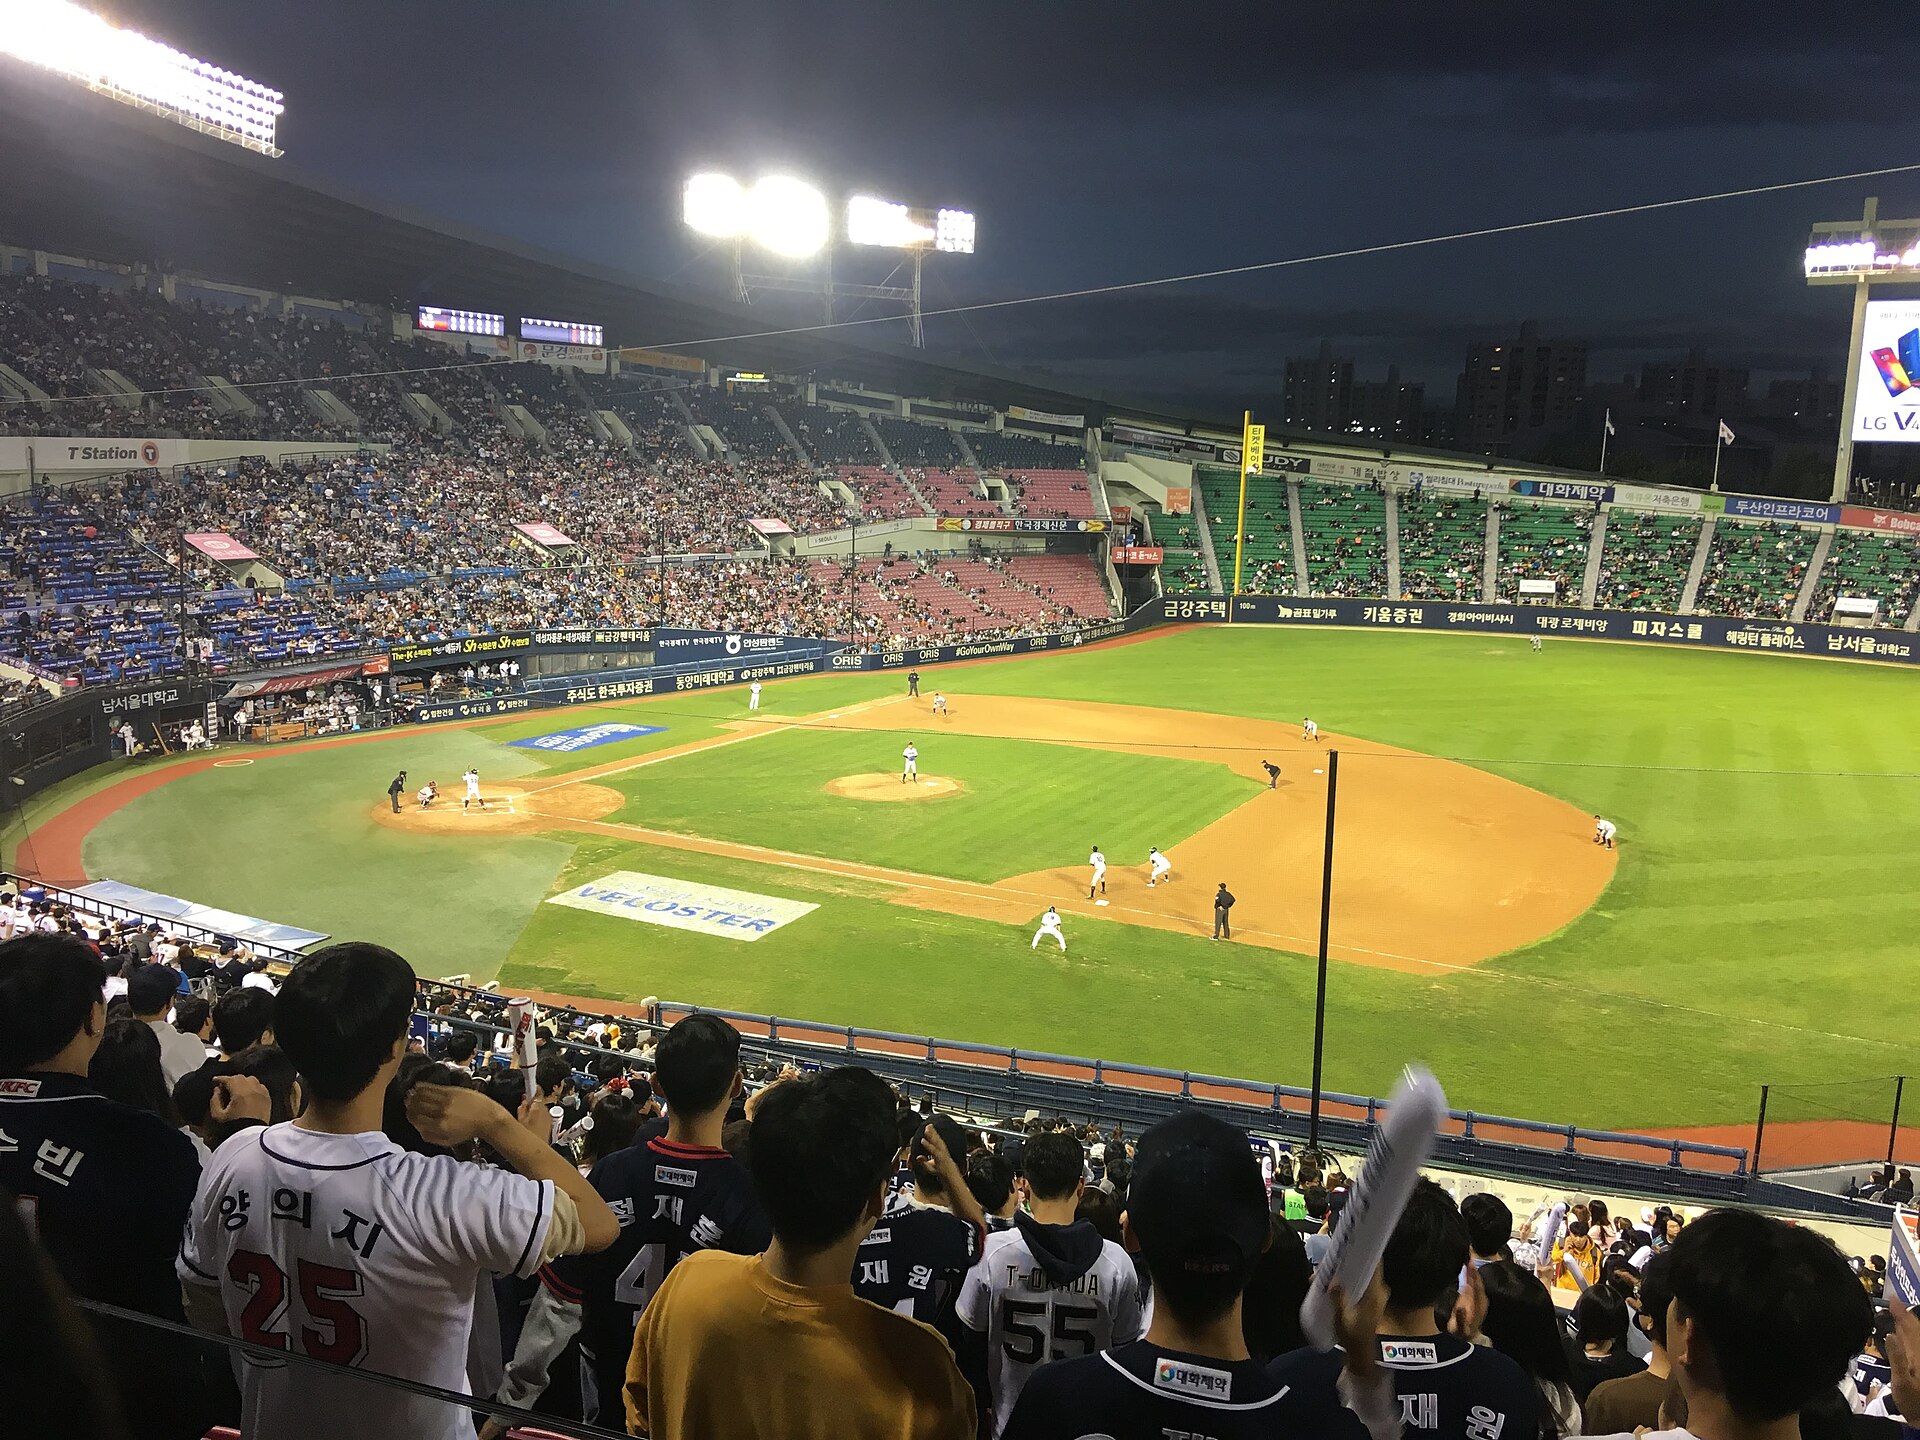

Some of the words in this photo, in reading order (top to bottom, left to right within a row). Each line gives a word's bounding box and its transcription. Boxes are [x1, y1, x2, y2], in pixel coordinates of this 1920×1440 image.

[1863, 416, 1887, 430] LG
[1893, 411, 1920, 431] V4
[1250, 427, 1261, 462] 티켓베이
[1539, 482, 1606, 500] 대화제약
[1735, 500, 1829, 521] 두산인프라코어
[1890, 516, 1920, 532] Bobca
[1164, 601, 1226, 618] 금강주택
[1239, 602, 1256, 610] 100m
[1363, 606, 1423, 624] 키움증권
[1447, 611, 1514, 625] 경희아이비샤시
[1536, 616, 1560, 629] 대광
[1560, 617, 1609, 633] 로제비앙
[1631, 620, 1703, 640] 피자스쿨
[498, 636, 511, 649] Sh
[605, 631, 651, 642] 금강펜테리움
[1029, 637, 1047, 647] ORIS
[1060, 633, 1074, 644] ORIS
[1726, 630, 1758, 646] 해링턴
[1760, 633, 1805, 649] 플레이스
[463, 639, 477, 653] Sh
[919, 648, 940, 659] ORIS
[955, 643, 1014, 657] #GoYourOwnWay
[832, 656, 862, 666] ORIS
[882, 652, 904, 664] ORIS
[675, 670, 735, 690] 동양미래대학교
[751, 666, 775, 678] 금강주택
[567, 686, 597, 703] 주식도
[598, 680, 653, 699] 한국투자증권
[101, 689, 179, 714] 남서울대학교
[578, 885, 776, 933] VELOSTER
[226, 1248, 370, 1369] 25
[1003, 1300, 1098, 1365] 55
[1176, 1368, 1227, 1393] 대화제약
